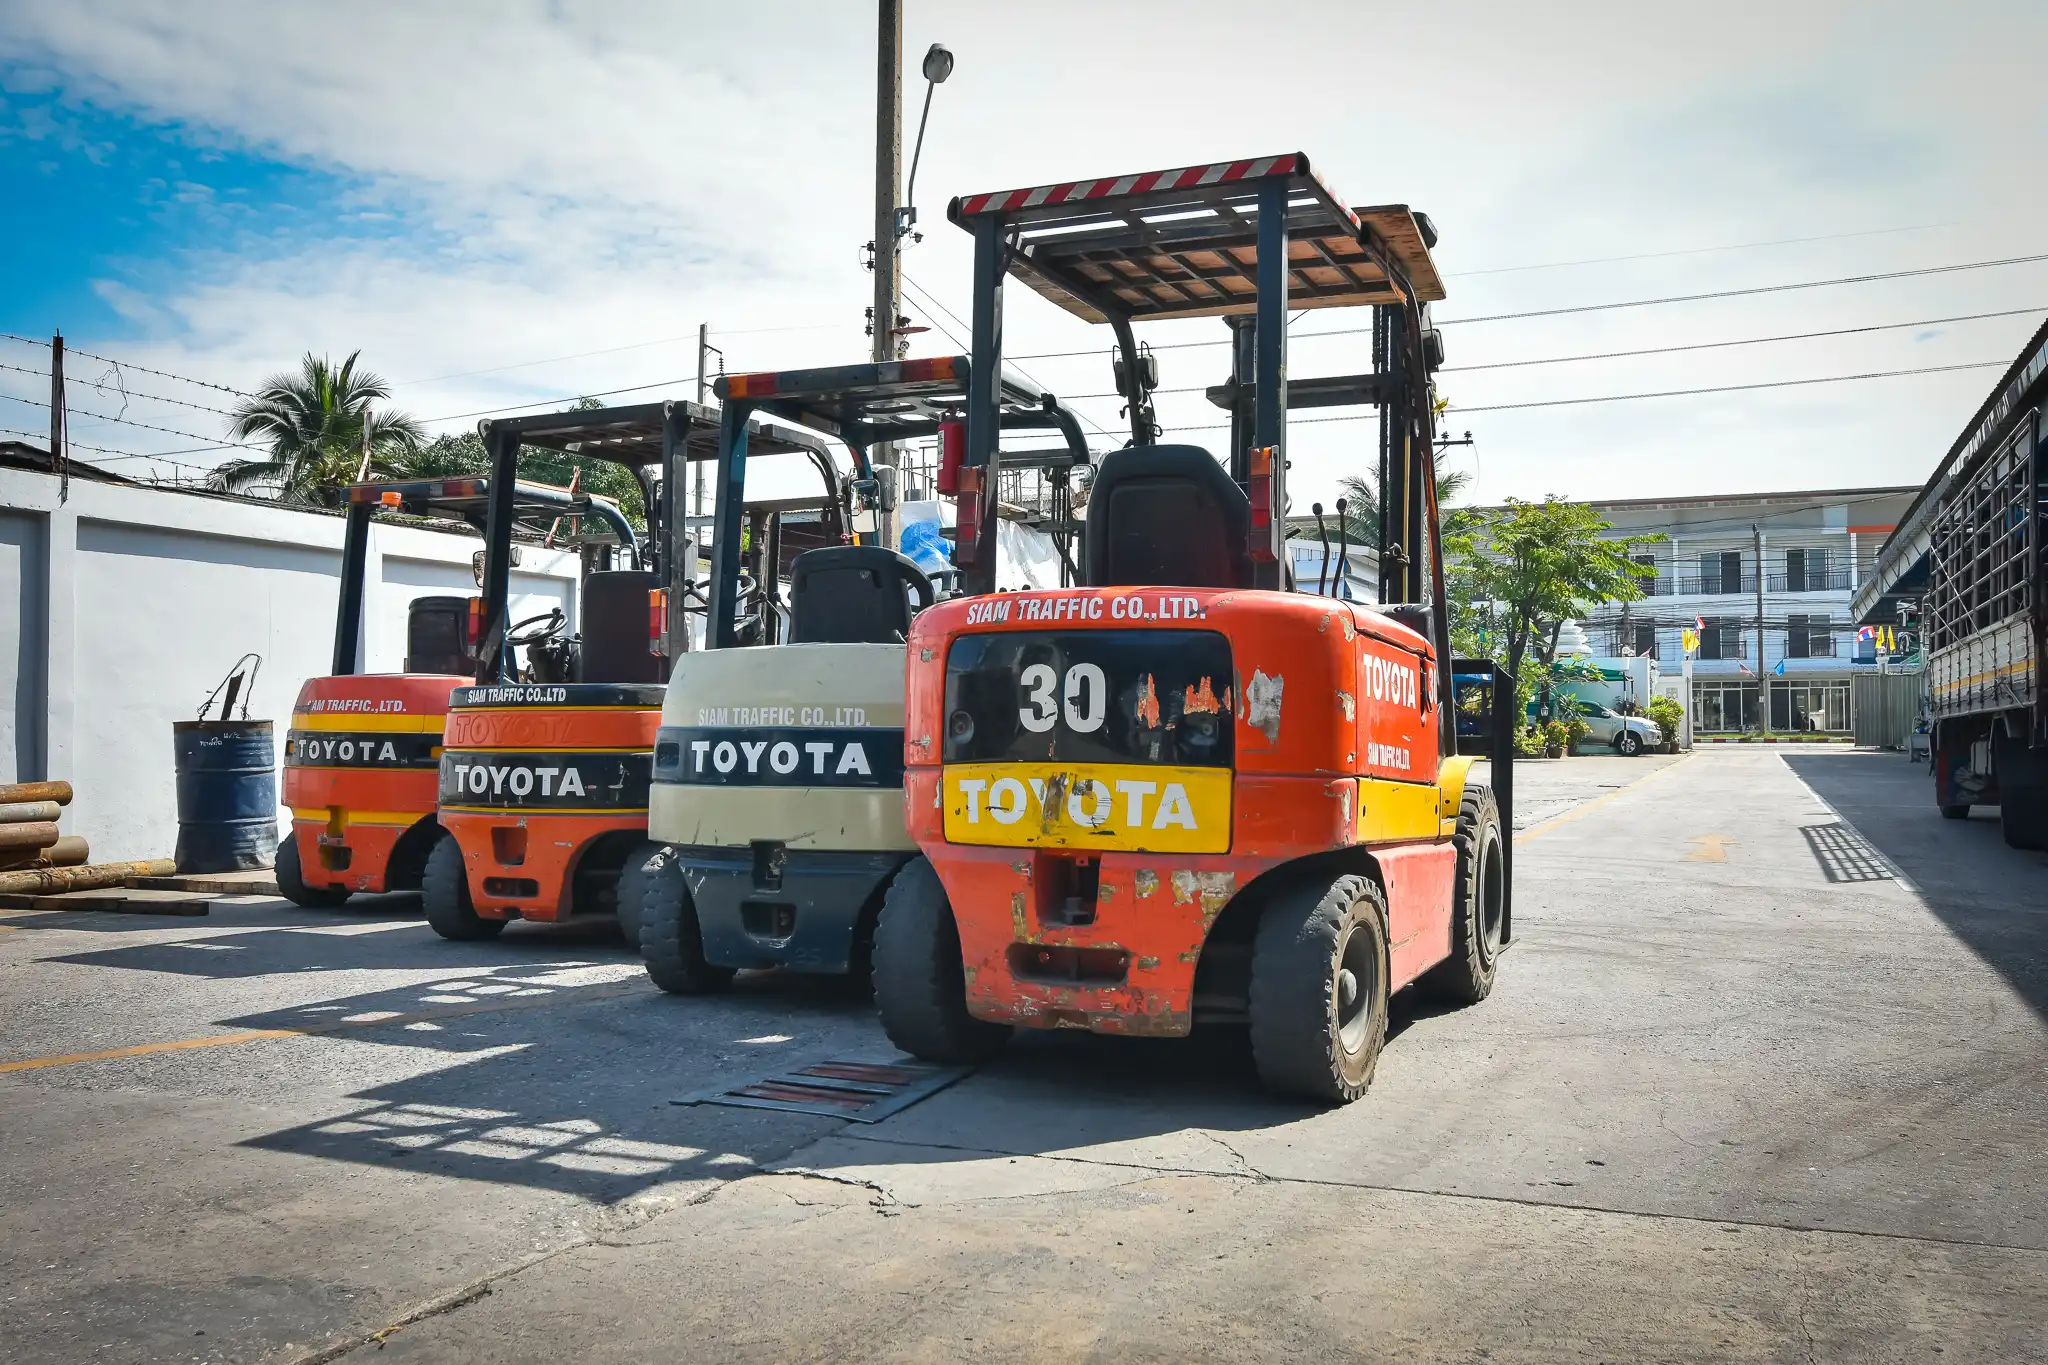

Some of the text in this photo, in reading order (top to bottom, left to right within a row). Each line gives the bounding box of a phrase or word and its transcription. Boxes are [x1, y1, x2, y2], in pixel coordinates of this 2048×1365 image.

[966, 602, 1012, 625] SIAM
[1018, 597, 1103, 620] TRAFFIC
[467, 688, 486, 704] SIAM
[488, 687, 524, 702] TRAFFIC
[1019, 662, 1106, 733] 30
[1363, 653, 1416, 710] TOYOTA
[456, 713, 596, 745] TOYOTA
[699, 707, 728, 726] SIAM
[733, 707, 795, 726] TRAFFIC
[299, 739, 397, 761] TOYOTA
[692, 741, 871, 775] TOYOTA
[455, 764, 586, 797] TOYOTA
